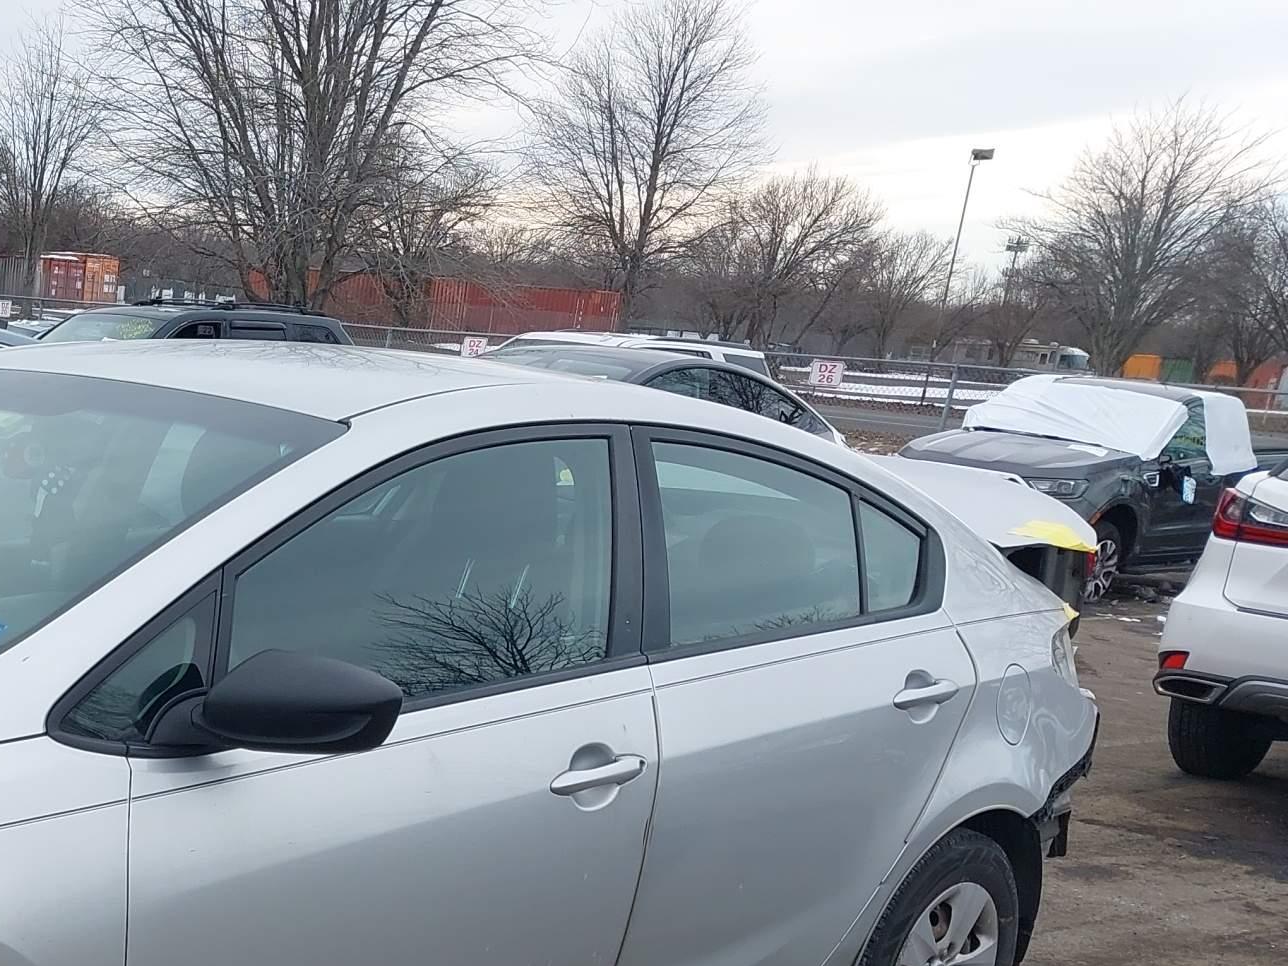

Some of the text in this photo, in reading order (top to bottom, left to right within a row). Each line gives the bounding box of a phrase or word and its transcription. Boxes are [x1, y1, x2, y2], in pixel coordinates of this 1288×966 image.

[468, 339, 482, 348] DZ
[468, 348, 479, 356] 24
[818, 363, 837, 374] DZ
[818, 374, 834, 384] 26
